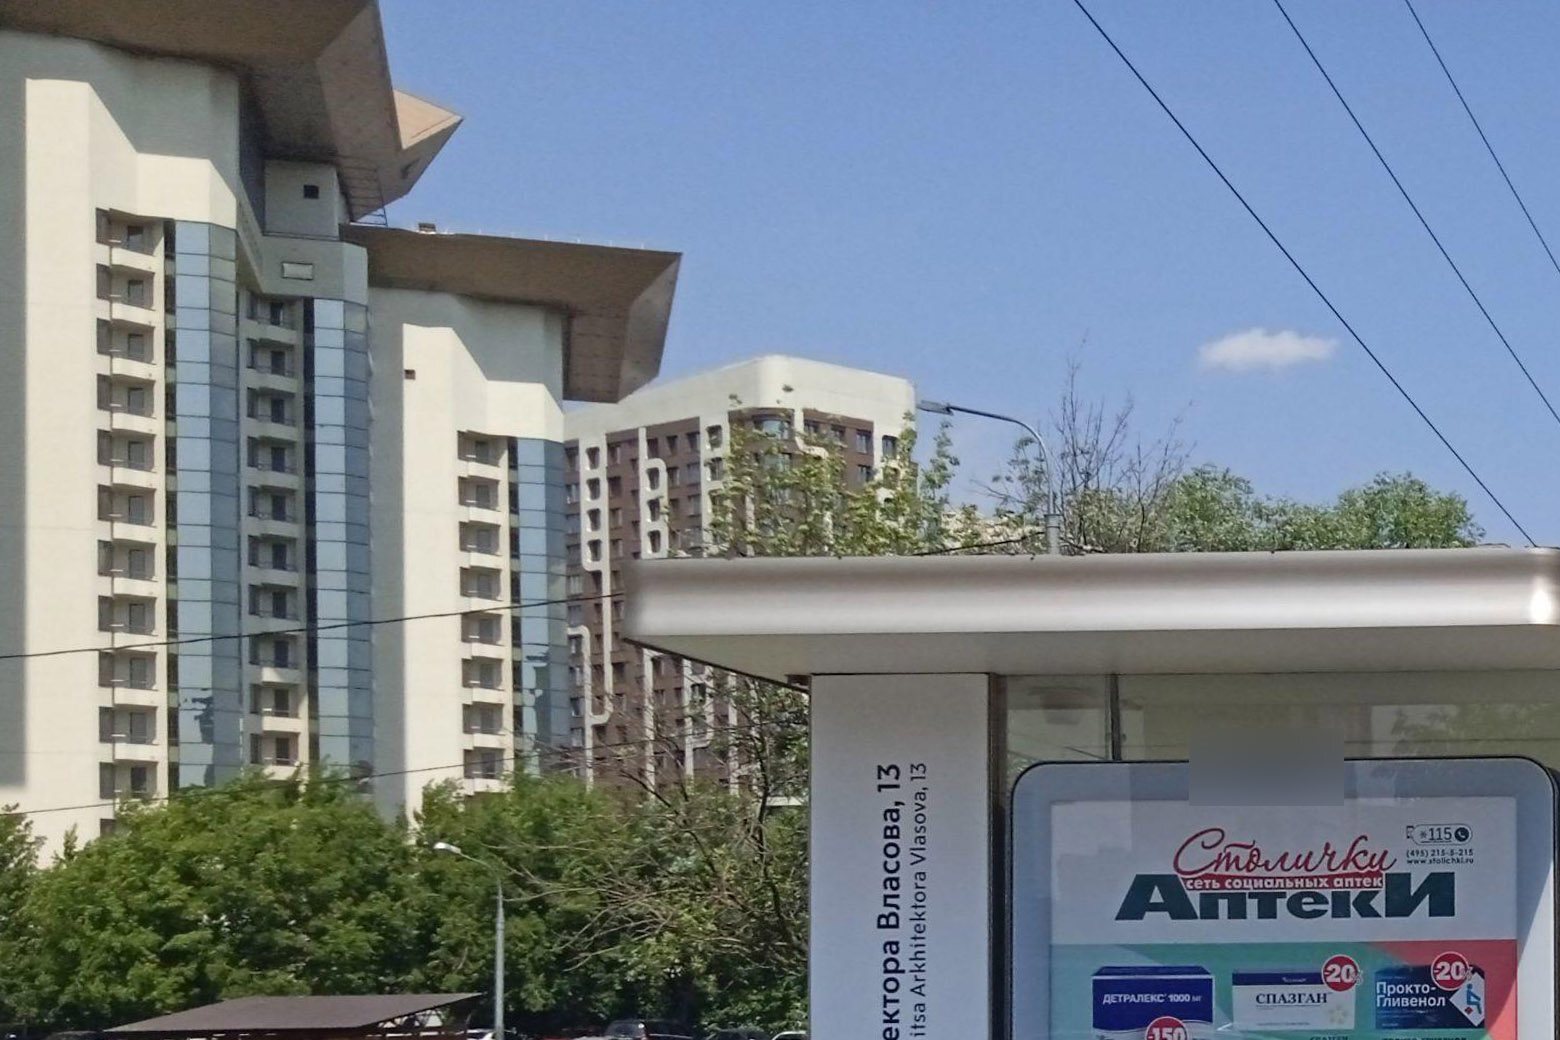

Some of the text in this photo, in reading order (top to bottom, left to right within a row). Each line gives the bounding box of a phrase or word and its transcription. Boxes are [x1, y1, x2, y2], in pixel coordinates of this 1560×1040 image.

[877, 763, 901, 793] 13
[910, 762, 927, 782] 13
[910, 786, 929, 866] Vlasova,
[1173, 827, 1397, 875] Столички
[877, 800, 905, 930] Власова,
[1186, 877, 1384, 891] сеть социальных аптек
[909, 871, 927, 997] Arkhitektora
[1168, 994, 1191, 1003] 1000
[1255, 992, 1328, 1004] СПАЗГАН
[1376, 981, 1437, 996] Прокто-
[1376, 995, 1446, 1007] Гливенол
